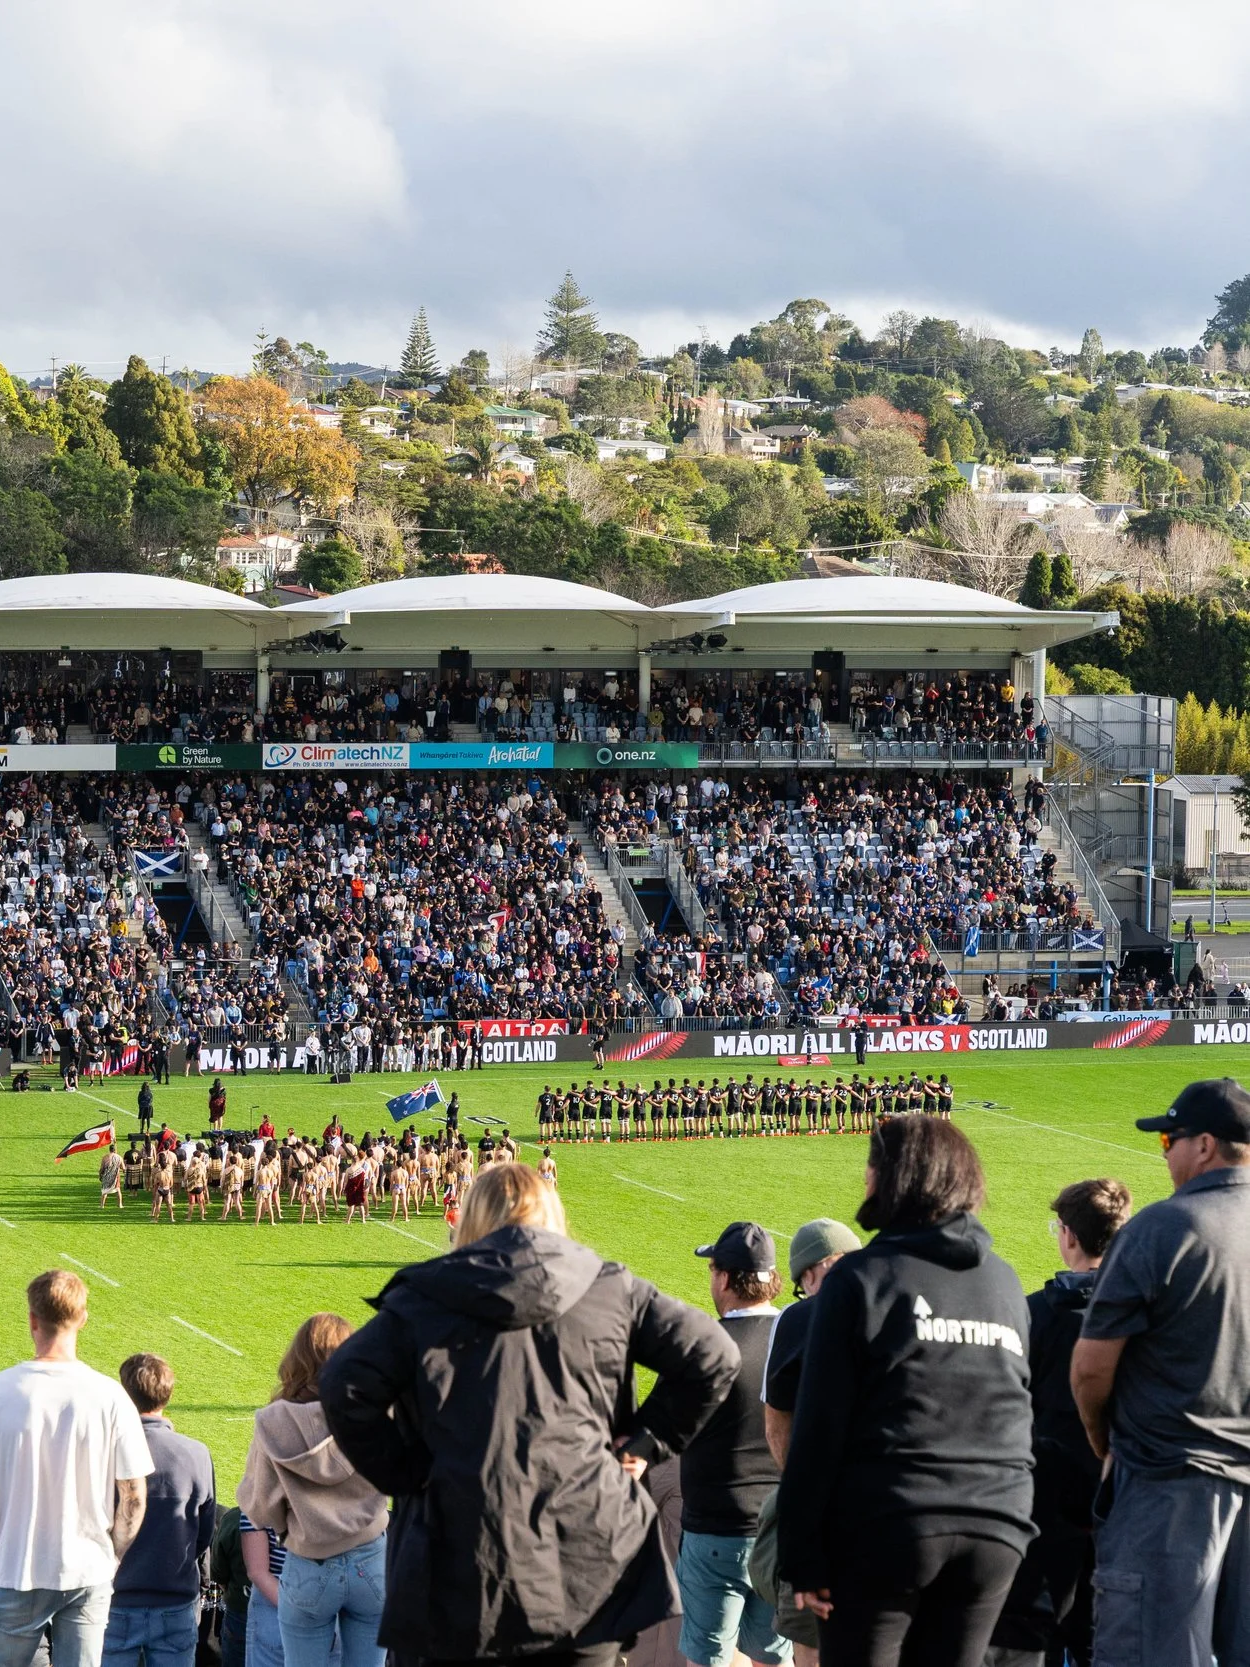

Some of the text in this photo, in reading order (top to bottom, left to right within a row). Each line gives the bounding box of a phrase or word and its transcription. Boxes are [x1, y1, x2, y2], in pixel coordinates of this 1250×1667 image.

[183, 747, 208, 755] Green
[301, 746, 404, 760] ClimatechNZ
[615, 751, 656, 760] one.nz
[183, 756, 221, 765] by Nature
[1194, 1020, 1250, 1044] MĀO
[714, 1032, 796, 1056] MĀORI
[800, 1033, 846, 1054] ALL
[968, 1028, 1048, 1049] SCOTLAND
[483, 1040, 556, 1063] COTLAND
[916, 1318, 1023, 1357] NORTHP
